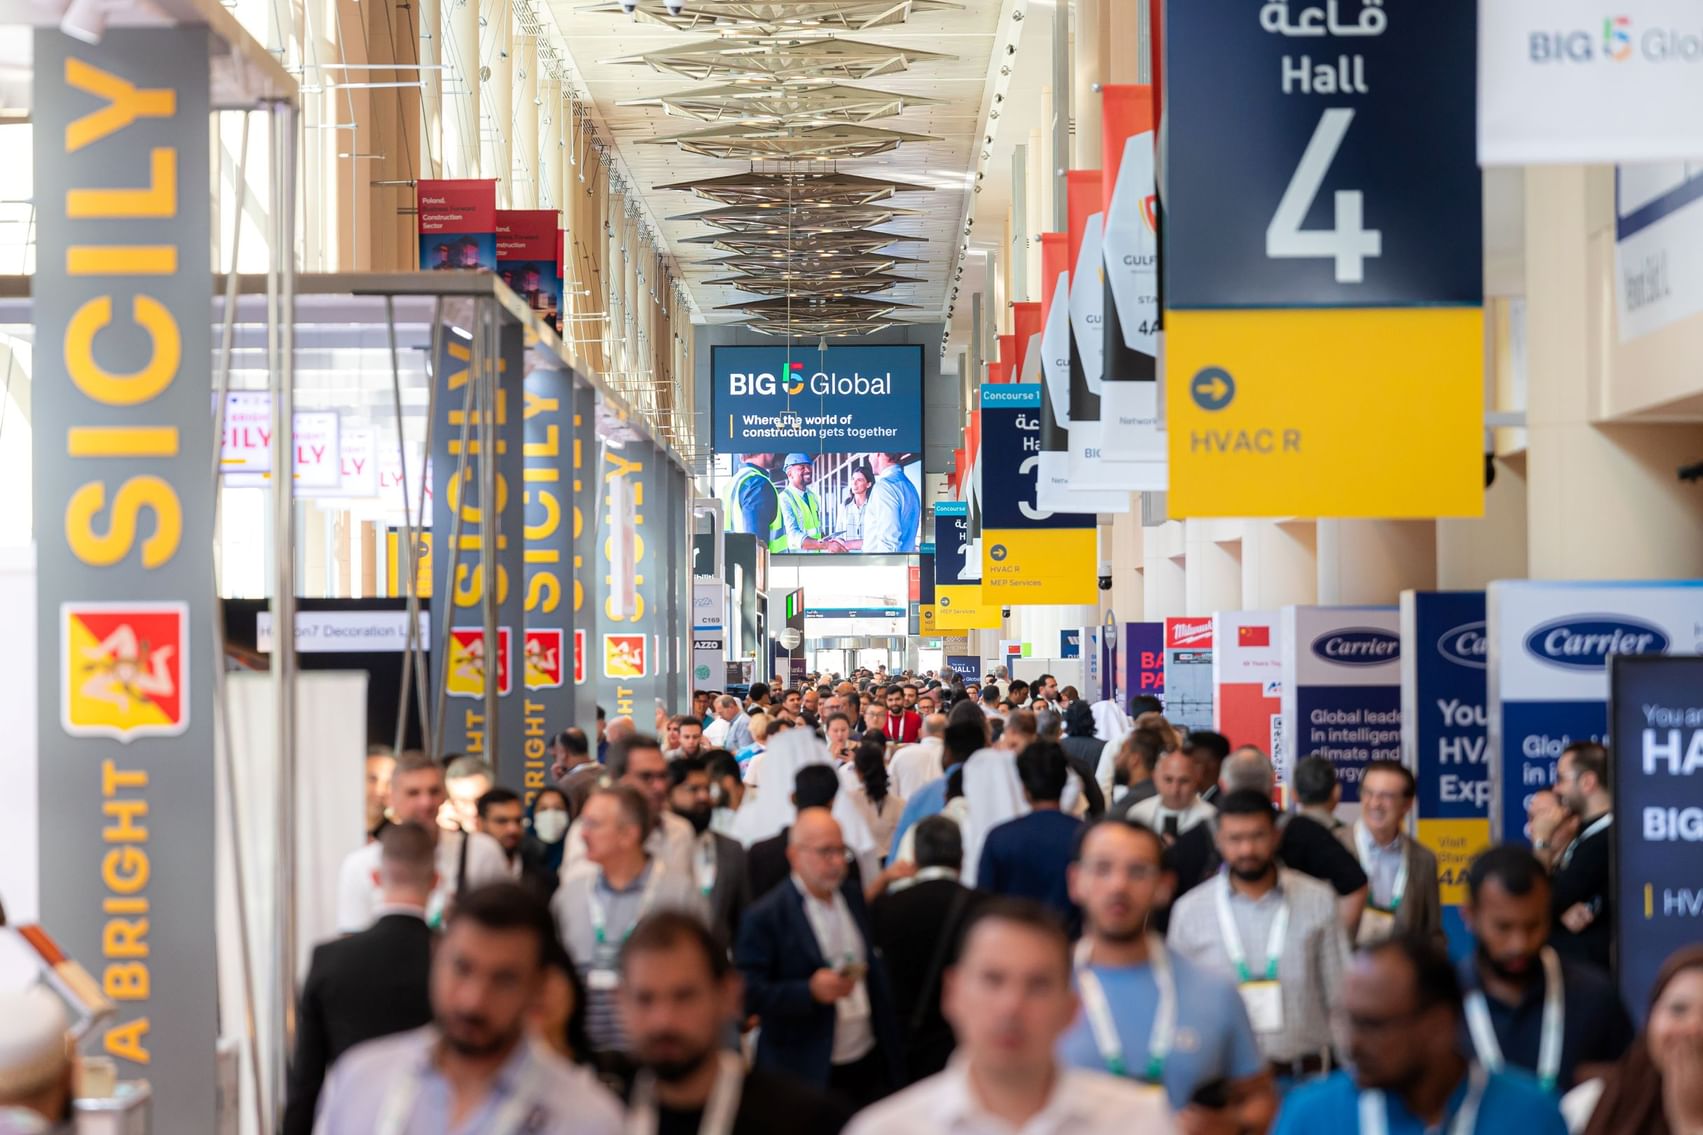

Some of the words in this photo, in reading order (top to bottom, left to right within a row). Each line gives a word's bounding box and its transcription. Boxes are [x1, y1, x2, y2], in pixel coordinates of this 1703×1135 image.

[1528, 29, 1593, 64] BIG
[1602, 15, 1634, 64] 5
[1281, 55, 1368, 94] Hall
[1265, 107, 1382, 284] 4
[422, 213, 463, 221] Construction
[63, 56, 183, 569] SICILY
[729, 373, 776, 396] BIG
[782, 361, 805, 395] 5
[810, 372, 891, 395] Global
[983, 391, 1034, 400] Concourse
[742, 415, 780, 425] Where
[783, 415, 802, 425] the
[805, 415, 837, 425] world
[840, 415, 853, 425] of
[742, 427, 817, 438] construction
[819, 428, 845, 440] gets
[847, 427, 897, 440] together
[1190, 429, 1275, 454] HVAC
[1283, 430, 1302, 452] R
[523, 390, 561, 614] SICILY
[936, 505, 966, 513] Concourse
[1009, 578, 1042, 587] Services
[323, 625, 395, 638] Decoration
[1543, 627, 1653, 657] Carrier
[1325, 636, 1398, 658] Carrier
[1310, 708, 1361, 725] Global
[1642, 704, 1683, 727] You
[1310, 727, 1326, 742] in
[1371, 745, 1401, 761] and
[102, 758, 151, 1000] BRIGHT
[104, 1017, 151, 1065] A
